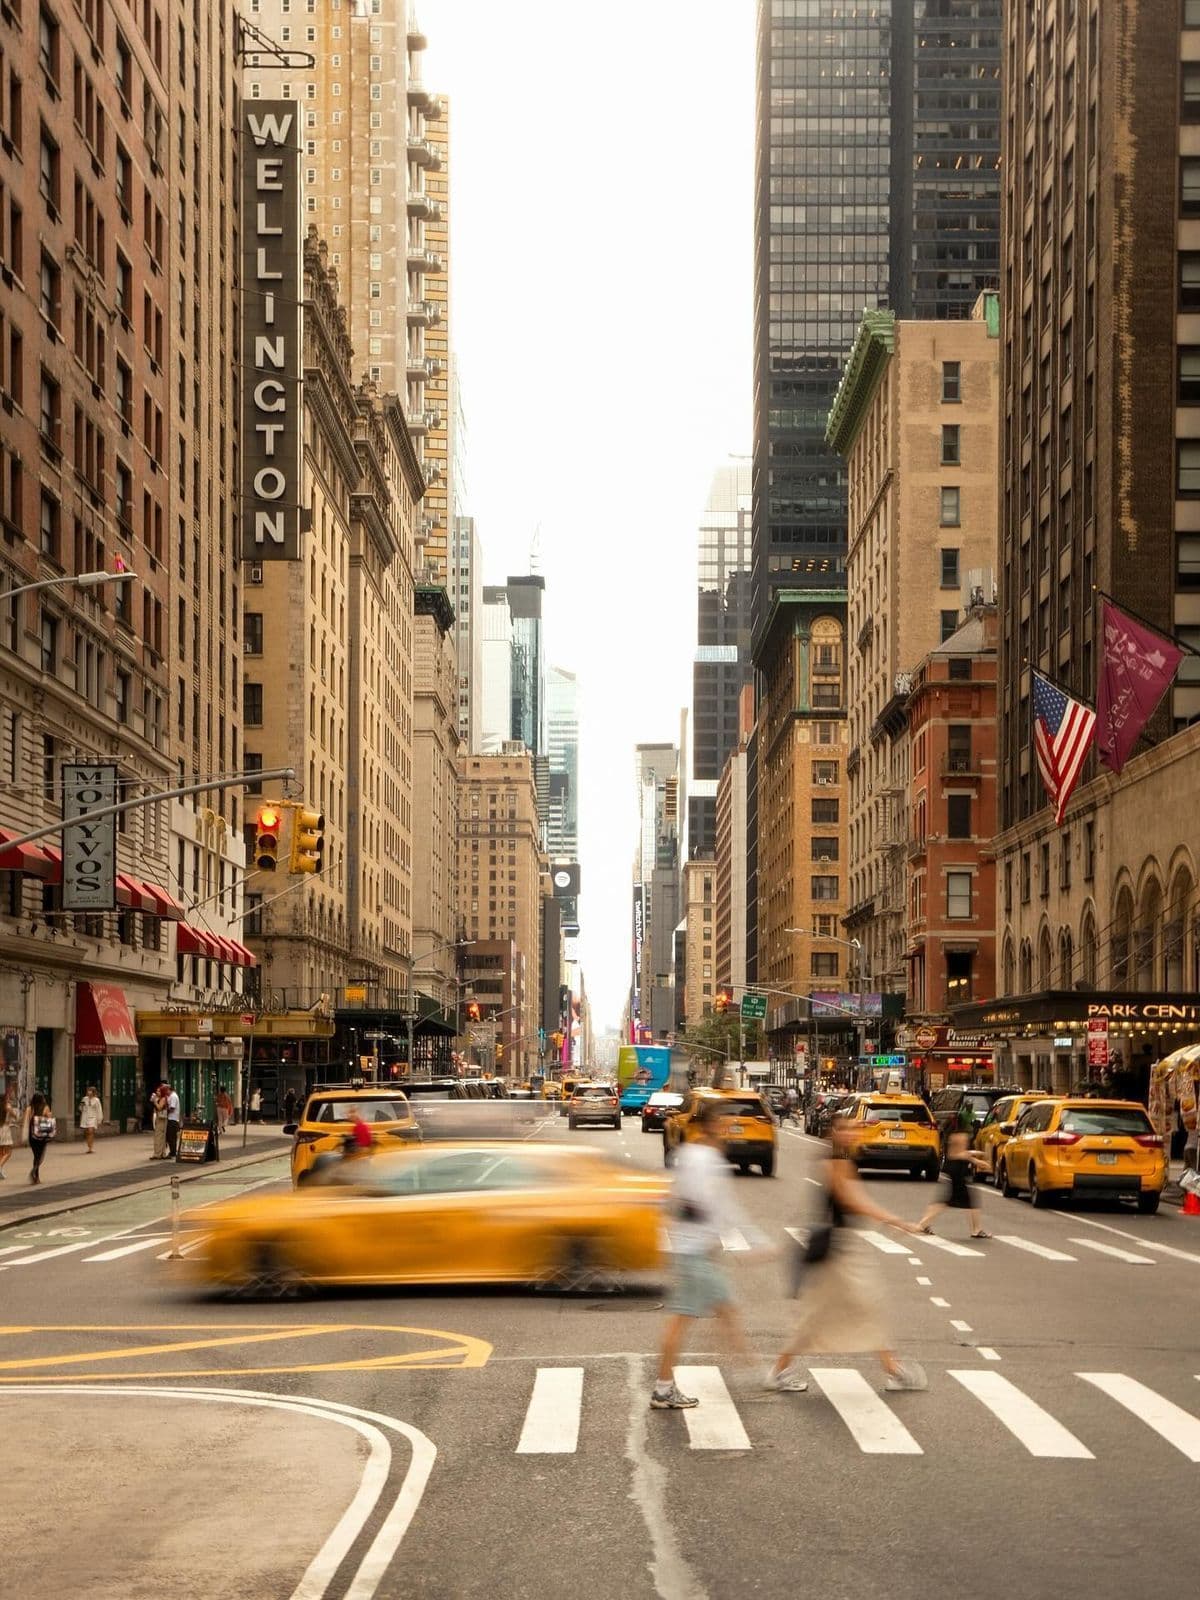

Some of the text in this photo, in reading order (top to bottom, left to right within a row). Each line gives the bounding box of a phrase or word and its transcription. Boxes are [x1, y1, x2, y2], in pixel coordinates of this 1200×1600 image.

[247, 113, 293, 543] WELLINGTON
[75, 771, 103, 892] MOLYVOS
[1088, 1004, 1138, 1017] PARK
